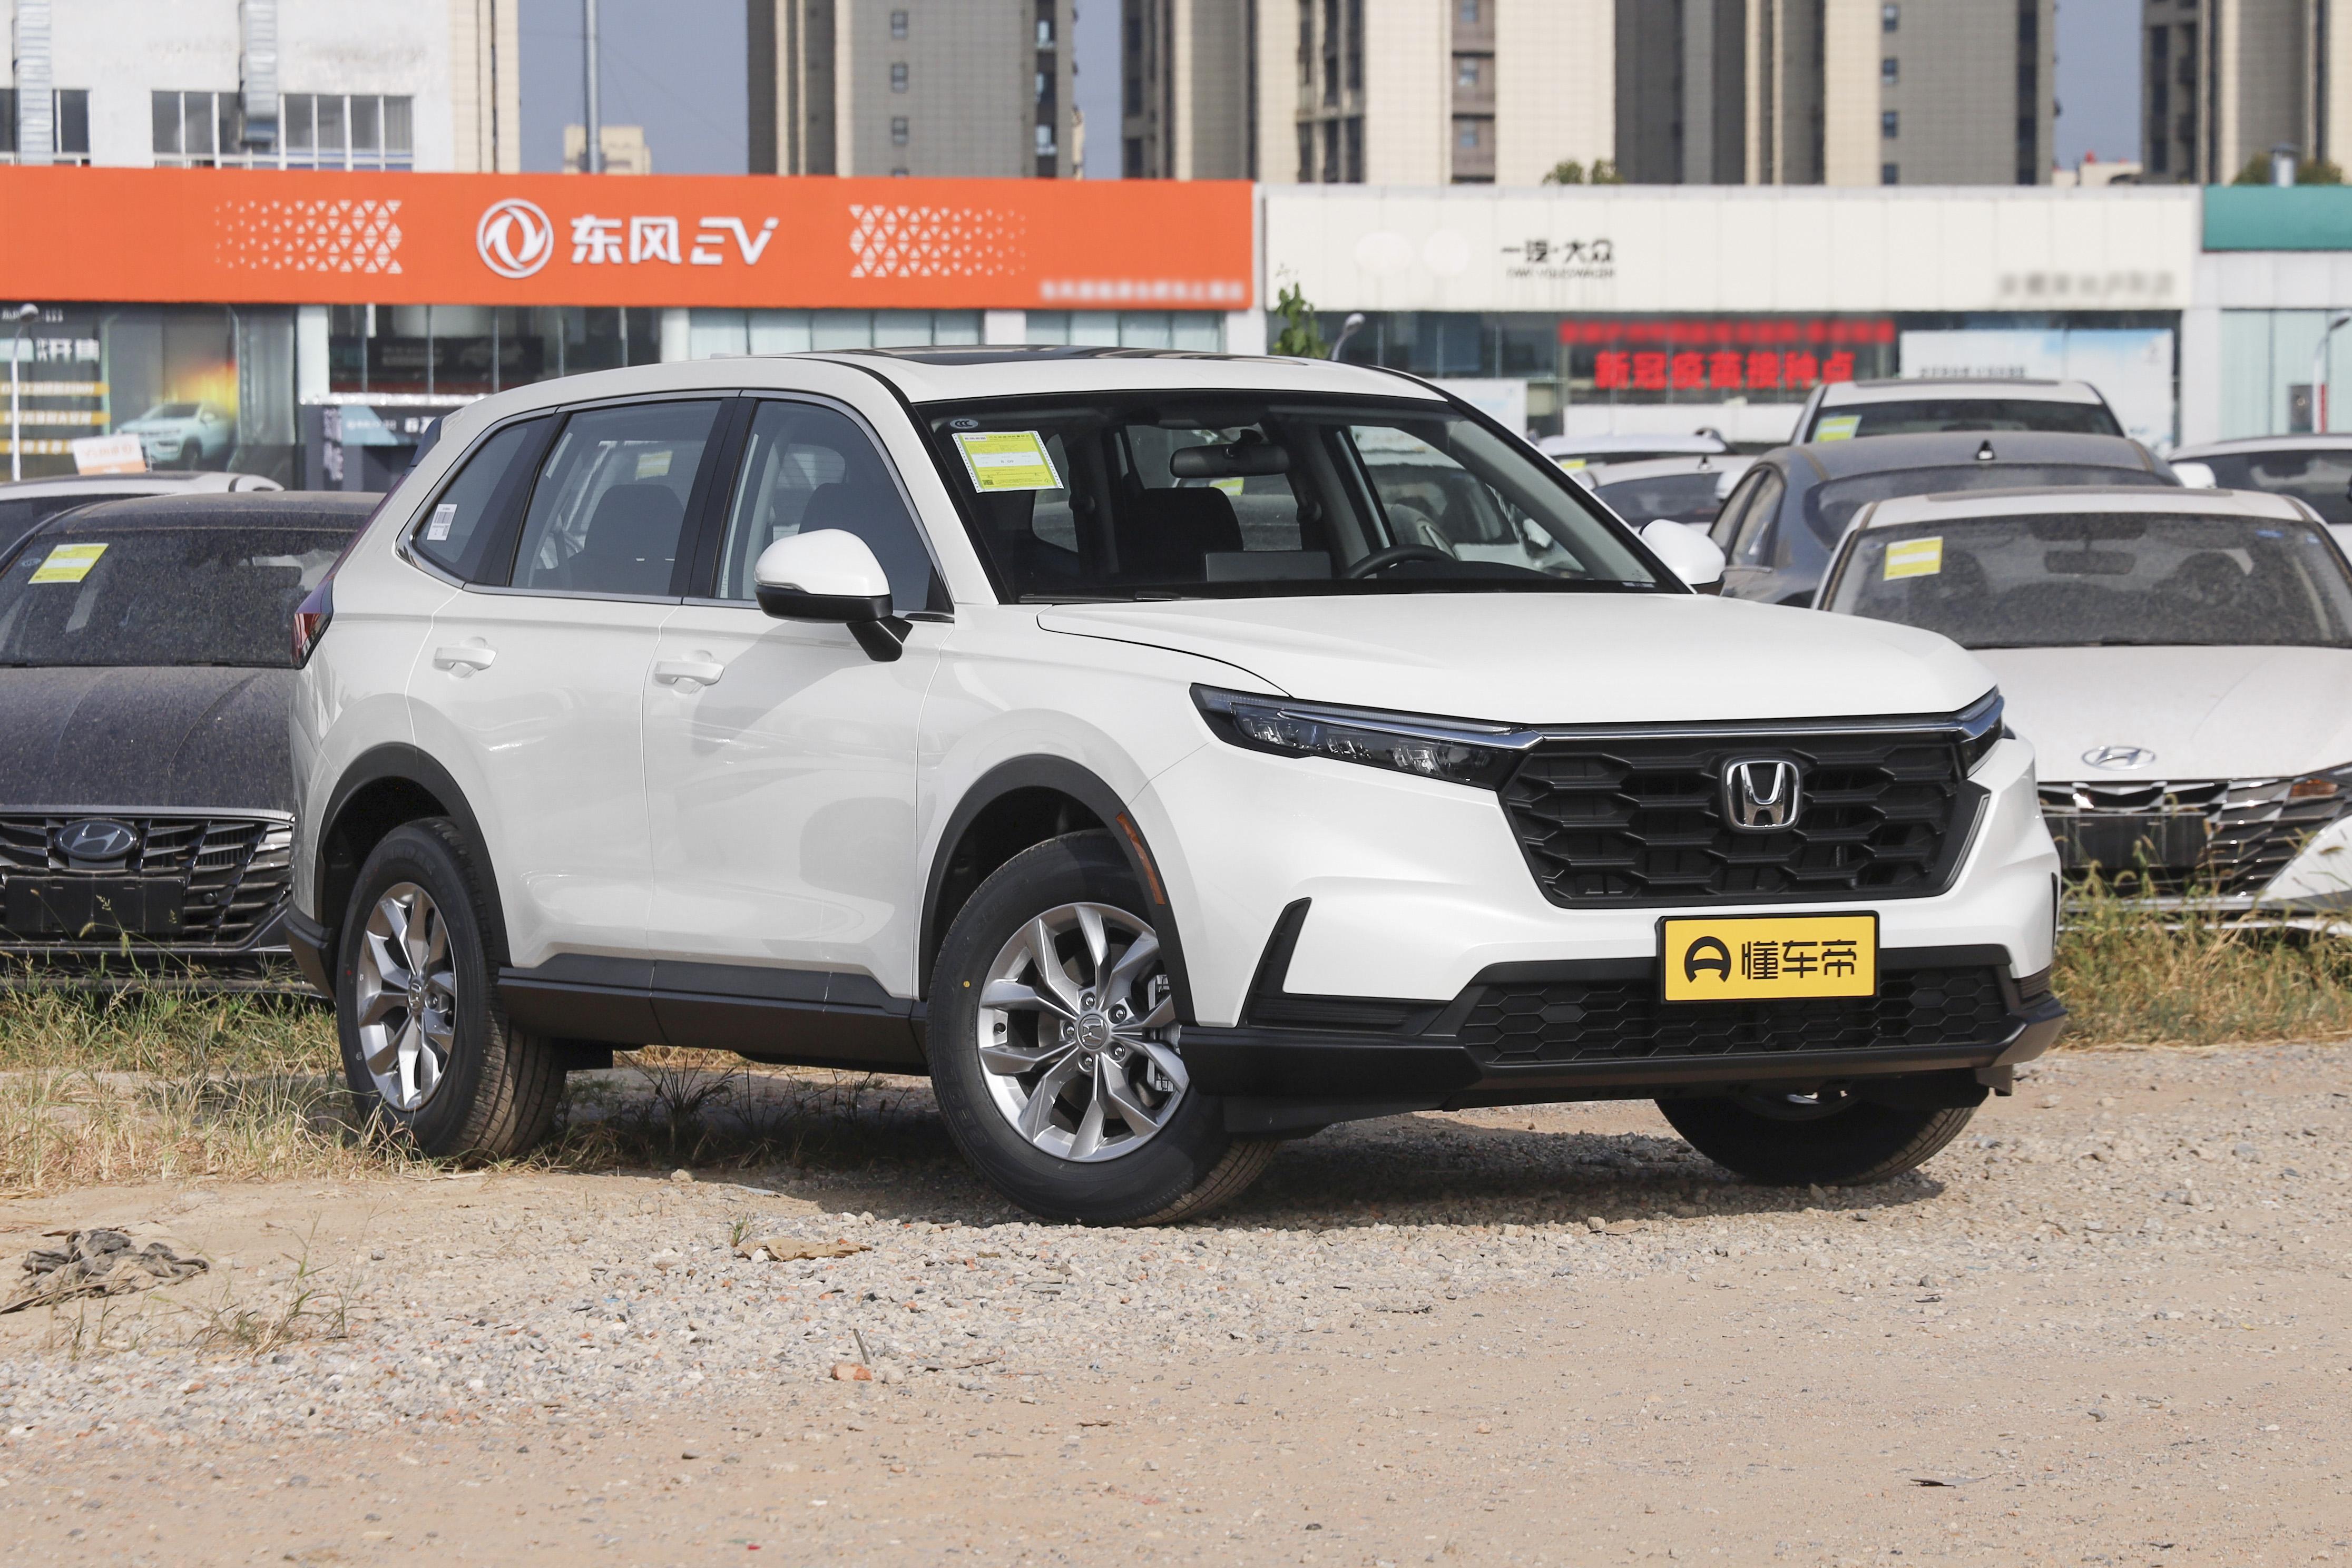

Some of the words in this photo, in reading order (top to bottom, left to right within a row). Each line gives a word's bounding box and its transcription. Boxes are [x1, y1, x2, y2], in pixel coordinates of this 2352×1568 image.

[1594, 351, 1855, 390] 新冠疫苗接种点
[1742, 939, 1857, 979] 懂车帝
